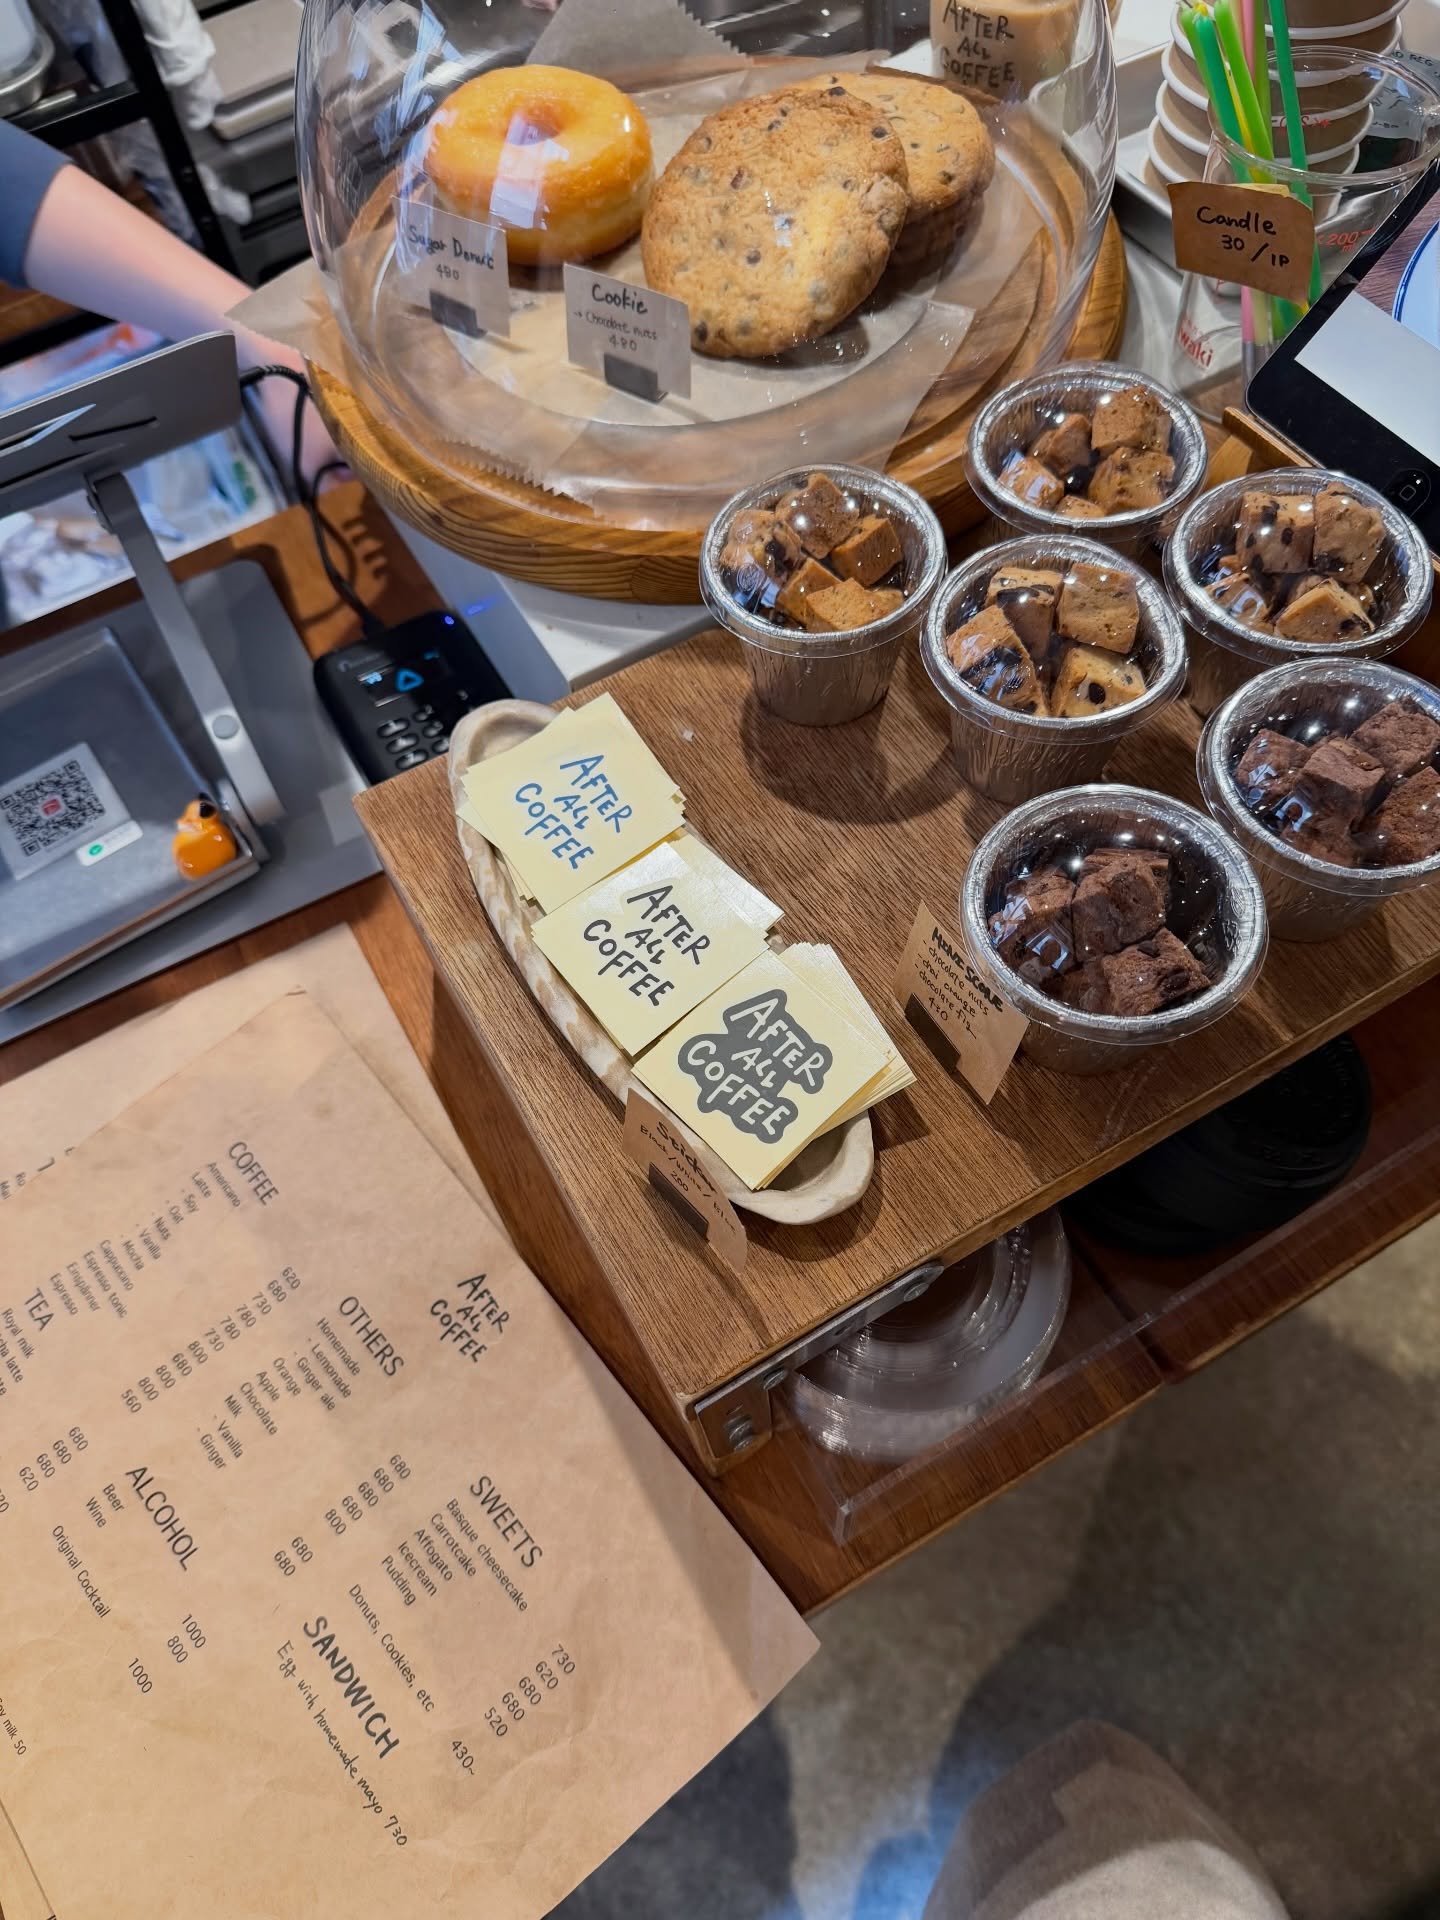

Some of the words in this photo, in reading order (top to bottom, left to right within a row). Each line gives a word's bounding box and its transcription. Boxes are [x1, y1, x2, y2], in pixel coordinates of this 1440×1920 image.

[943, 0, 1014, 39] AFTER
[957, 36, 990, 60] ALL
[940, 47, 1015, 88] COFFEE
[1196, 205, 1277, 236] Candle
[408, 224, 448, 256] Sugar
[1220, 234, 1246, 252] 30
[591, 282, 649, 315] Cookie
[559, 754, 633, 833] AFTER
[515, 782, 595, 870] COFFEE
[553, 794, 590, 830] ALL
[626, 884, 711, 966] AFTER
[583, 918, 676, 1007] COFFEE
[624, 927, 667, 965] ALL
[928, 946, 965, 991] chocolate
[968, 990, 989, 1016] nuts
[943, 982, 976, 1018] orange
[729, 997, 826, 1088] AFTER
[730, 1046, 777, 1089] ALL
[686, 1039, 792, 1136] COFFEE
[191, 1171, 212, 1199] Latte
[206, 1162, 241, 1208] Americano
[228, 1141, 280, 1206] COFFEE
[168, 1205, 185, 1225] Oat
[183, 1193, 199, 1214] Soy
[138, 1228, 162, 1260] Vanilla
[153, 1216, 172, 1241] Nuts
[121, 1239, 145, 1271] Mocha
[49, 1272, 79, 1316] Espresso
[82, 1250, 113, 1293] Espresso
[107, 1291, 129, 1319] tonic
[266, 1279, 287, 1303] 680
[281, 1266, 301, 1291] 620
[23, 1287, 55, 1332] TEA
[235, 1303, 257, 1328] 780
[251, 1291, 272, 1316] 730
[455, 1304, 482, 1334] ALL
[456, 1272, 510, 1335] AFTER
[1, 1307, 23, 1337] Royal
[17, 1337, 35, 1360] milk
[203, 1327, 225, 1352] 730
[219, 1315, 241, 1340] 780
[338, 1295, 405, 1378] OTHERS
[429, 1298, 488, 1364] COFFEE
[186, 1340, 209, 1365] 800
[315, 1316, 361, 1377] Homemade
[5, 1355, 24, 1384] latte
[154, 1364, 177, 1390] 800
[171, 1352, 193, 1377] 680
[272, 1357, 302, 1397] Orange
[310, 1342, 352, 1399] Lemonade
[137, 1376, 160, 1401] 800
[255, 1370, 281, 1403] Apple
[296, 1353, 324, 1393] Ginger
[319, 1392, 336, 1412] ale
[120, 1388, 143, 1414] 560
[223, 1393, 243, 1419] Milk
[239, 1381, 278, 1436] Chocolate
[52, 1439, 73, 1465] 680
[68, 1426, 89, 1452] 680
[199, 1433, 227, 1469] Ginger
[216, 1419, 244, 1459] Vanilla
[18, 1466, 40, 1492] 620
[36, 1452, 56, 1479] 680
[372, 1467, 395, 1495] 680
[389, 1454, 412, 1481] 680
[101, 1482, 125, 1512] Beer
[341, 1495, 364, 1522] 680
[357, 1481, 380, 1508] 680
[85, 1495, 107, 1529] Wine
[124, 1466, 199, 1572] ALCOHOL
[324, 1508, 347, 1536] 800
[469, 1475, 544, 1569] SWEETS
[291, 1536, 314, 1564] 680
[413, 1528, 453, 1582] Affogato
[429, 1512, 477, 1577] Carrotcake
[445, 1497, 479, 1545] Basque
[476, 1543, 528, 1612] cheesecake
[52, 1525, 83, 1571] Original
[76, 1569, 112, 1619] Cocktail
[273, 1549, 297, 1577] 680
[397, 1540, 438, 1598] Icecream
[380, 1554, 417, 1607] Pudding
[181, 1613, 207, 1649] 1000
[166, 1635, 189, 1664] 800
[348, 1583, 381, 1636] Donuts,
[380, 1633, 416, 1689] Cookies,
[416, 1688, 435, 1713] etc
[551, 1643, 576, 1676] 730
[127, 1657, 153, 1694] 1000
[302, 1615, 401, 1760] SANDWICH
[518, 1675, 542, 1706] 680
[535, 1660, 559, 1691] 620
[484, 1706, 509, 1738] 520
[501, 1691, 526, 1723] 680
[2, 1718, 18, 1740] milk
[13, 1739, 27, 1756] 50
[276, 1639, 297, 1679] Egg
[297, 1679, 320, 1711] with
[312, 1707, 361, 1780] homemade
[356, 1776, 383, 1815] mayo
[383, 1814, 408, 1847] 730
